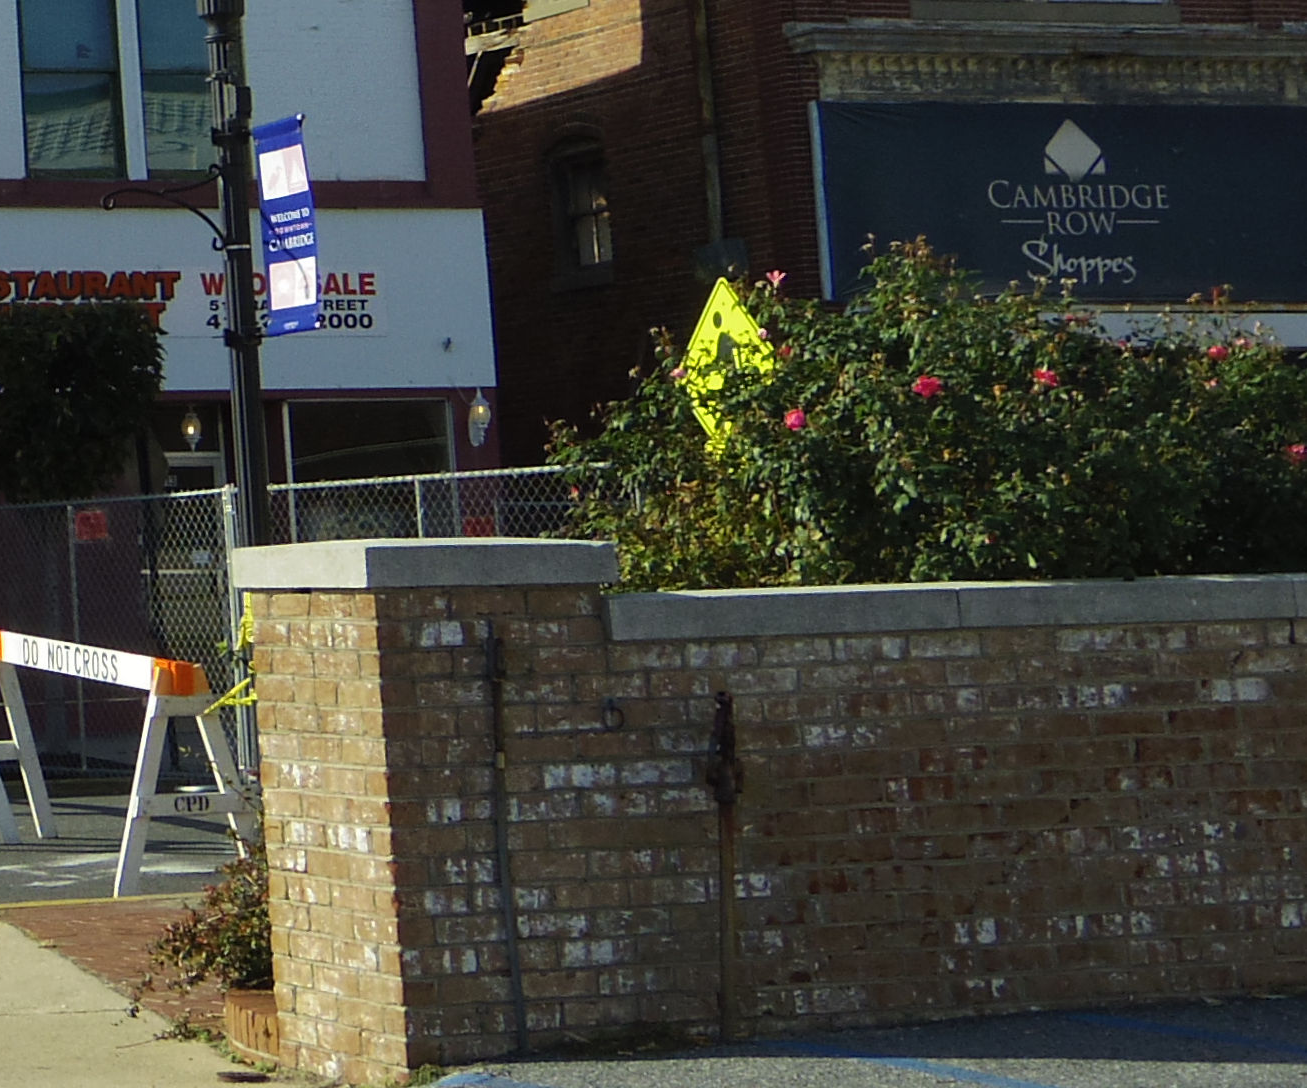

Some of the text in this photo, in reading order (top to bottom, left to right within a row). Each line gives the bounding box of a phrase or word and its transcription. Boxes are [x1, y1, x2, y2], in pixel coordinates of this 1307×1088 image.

[988, 179, 1169, 209] CAMBRIDGE
[270, 209, 300, 223] WELCOME
[1047, 211, 1116, 235] ROW
[1021, 233, 1137, 284] Shoppes
[23, 637, 39, 666] DO
[173, 795, 210, 813] CPD
